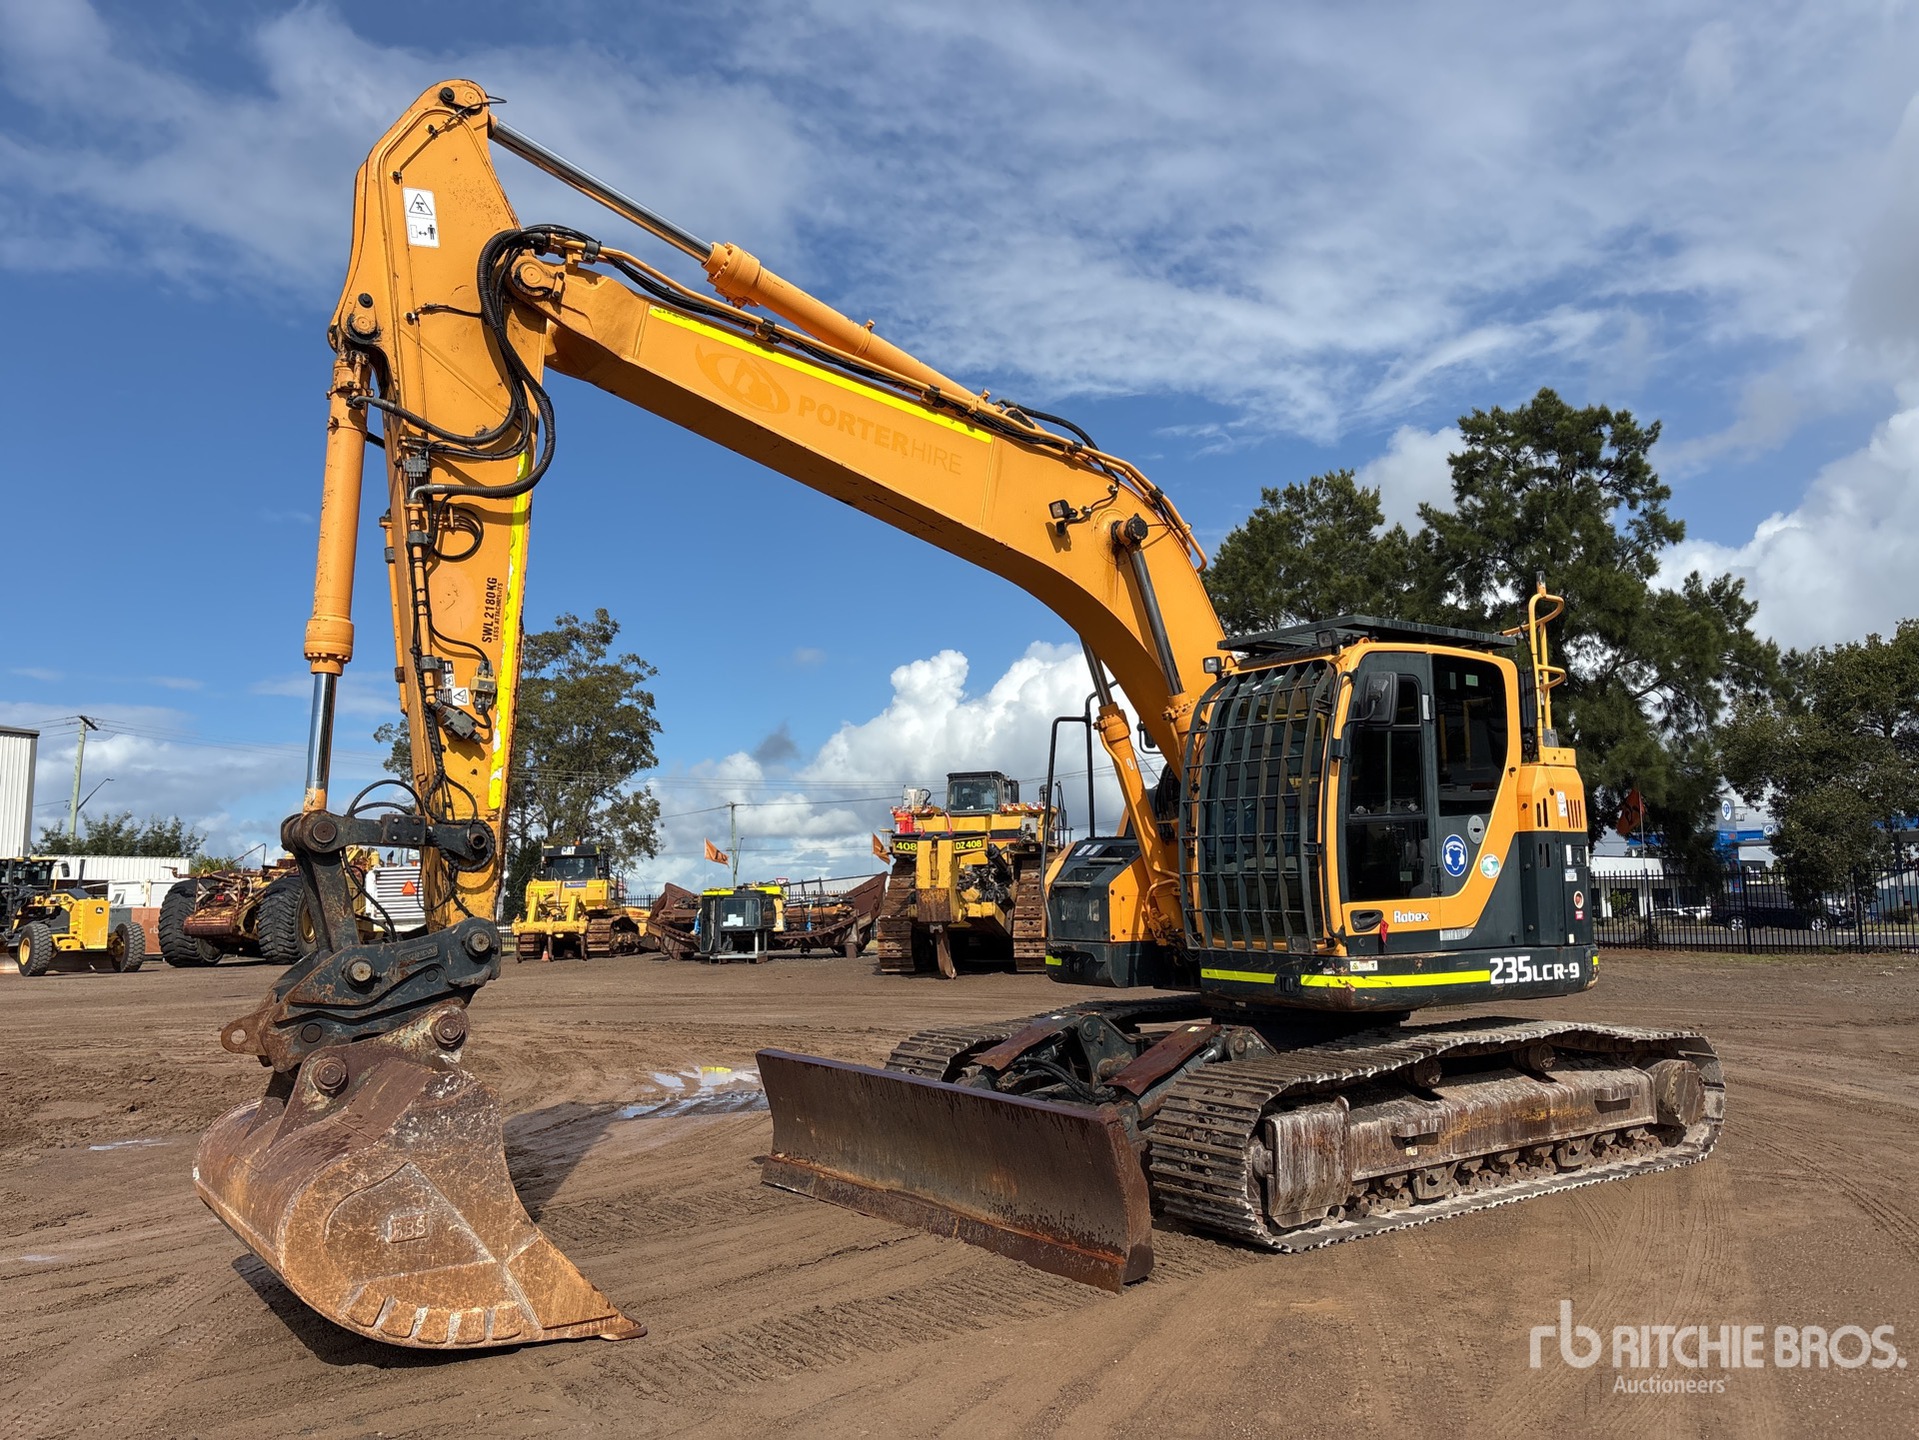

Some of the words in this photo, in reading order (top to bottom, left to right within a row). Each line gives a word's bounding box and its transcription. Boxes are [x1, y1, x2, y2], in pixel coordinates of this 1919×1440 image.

[481, 621, 494, 643] SWL
[561, 846, 576, 855] CAT
[896, 841, 917, 852] 408
